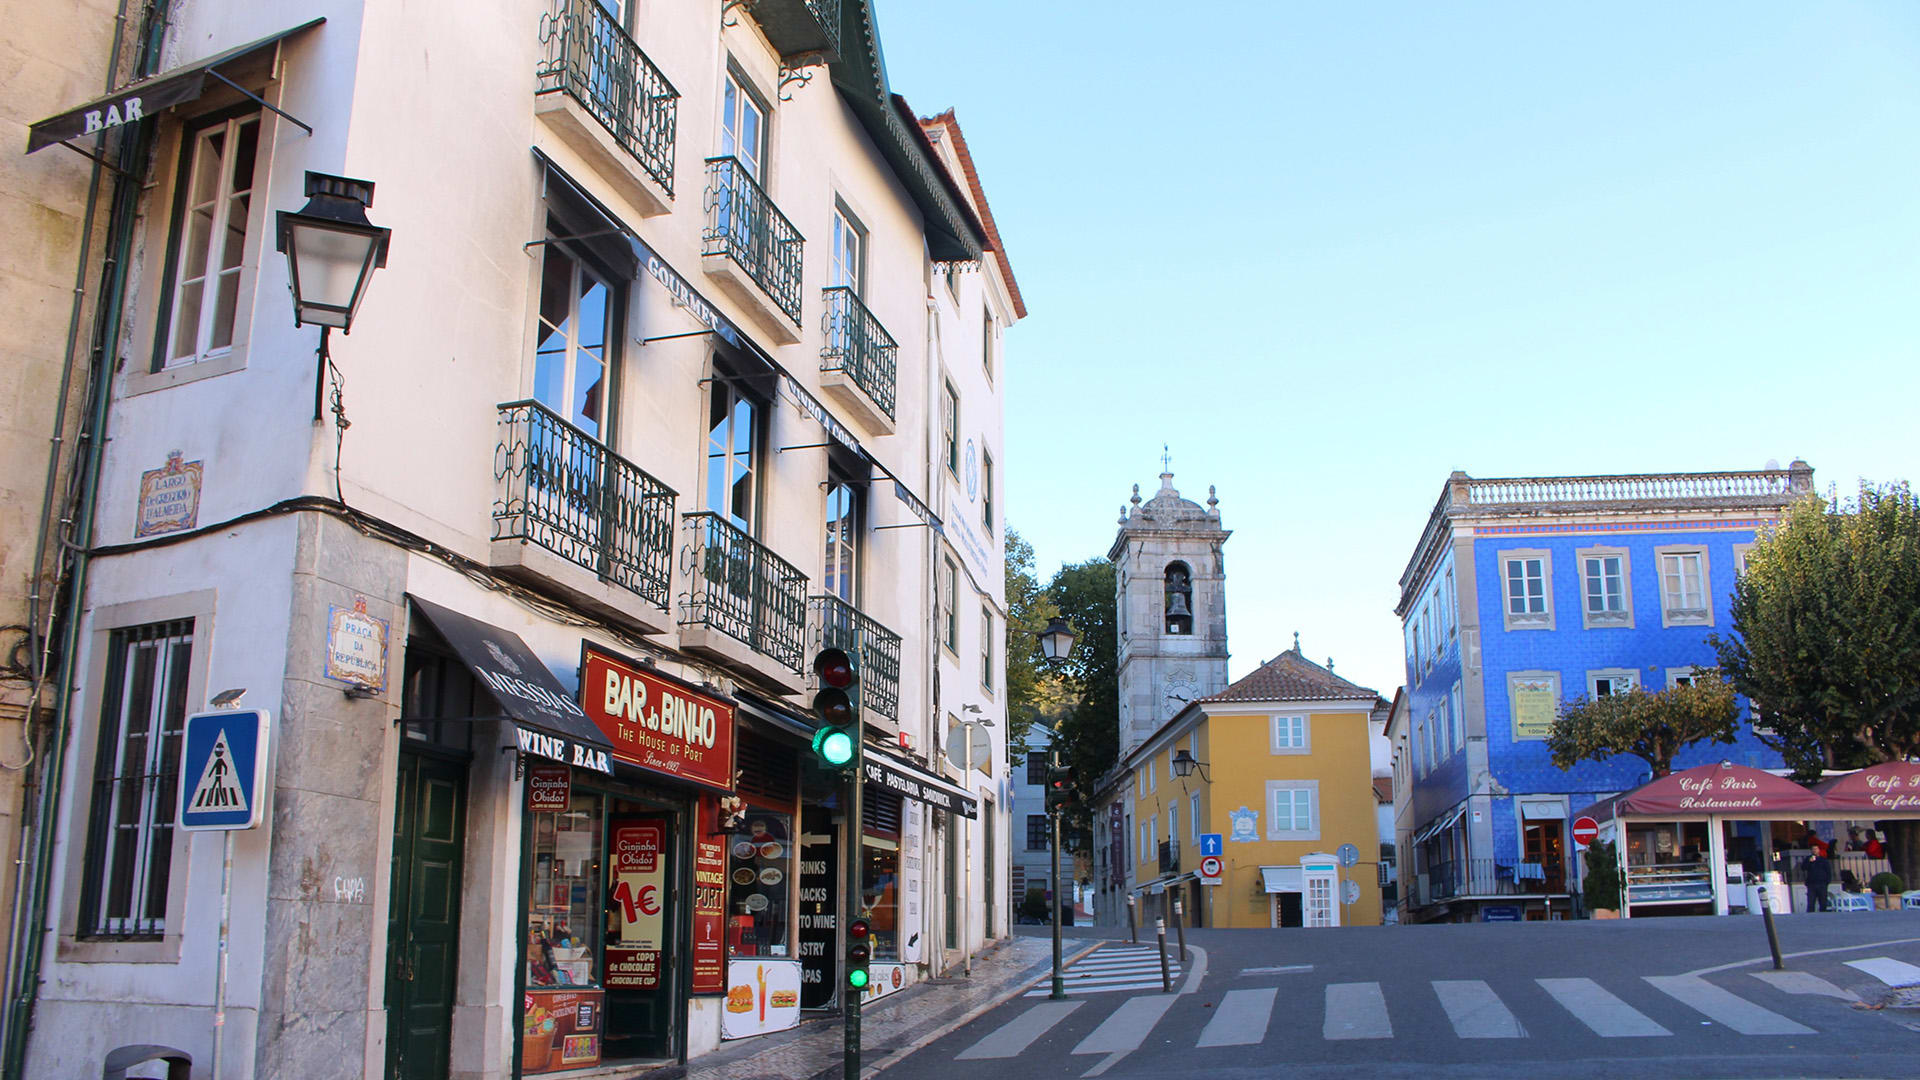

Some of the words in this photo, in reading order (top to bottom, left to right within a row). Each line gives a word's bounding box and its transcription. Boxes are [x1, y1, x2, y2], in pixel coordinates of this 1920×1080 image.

[84, 97, 144, 135] BAR
[648, 256, 719, 332] GOURMET
[788, 381, 822, 421] VINHO
[824, 415, 830, 431] A
[832, 424, 858, 453] COPO
[155, 475, 186, 490] LARGO
[345, 622, 373, 639] PRAÇA
[353, 640, 364, 652] DA
[474, 665, 584, 717] MESSIAS
[604, 668, 647, 728] BAR
[647, 706, 660, 732] do
[661, 691, 716, 750] BINHO
[516, 727, 565, 761] WINE
[572, 743, 611, 774] BAR
[617, 723, 634, 742] THE
[639, 730, 665, 753] HOUSE
[670, 743, 681, 756] OF
[684, 745, 703, 763] PORT
[643, 750, 662, 768] Since
[531, 776, 568, 791] Ginjinha
[866, 764, 882, 783] CAFÉ
[886, 772, 920, 797] PASTELARIA
[1680, 777, 1713, 796] Café
[1721, 776, 1757, 790] Paris
[1866, 775, 1901, 793] Café
[532, 789, 565, 802] Óbidos
[1680, 796, 1762, 809] Restaurante
[618, 840, 656, 854] Ginjinha
[621, 851, 654, 865] Óbidos
[800, 860, 826, 875] RINKS
[696, 870, 724, 884] VINTAGE
[695, 886, 725, 909] PORT
[800, 887, 827, 902] NACKS
[613, 881, 661, 924] 1€
[813, 914, 836, 929] WINE
[798, 941, 825, 956] ASTRY
[636, 952, 655, 962] COPO
[609, 963, 618, 972] de
[619, 963, 655, 973] CHOCOLATE
[611, 976, 643, 985] CHOCOLATE
[643, 976, 656, 986] CUP
[801, 968, 822, 984] APAS
